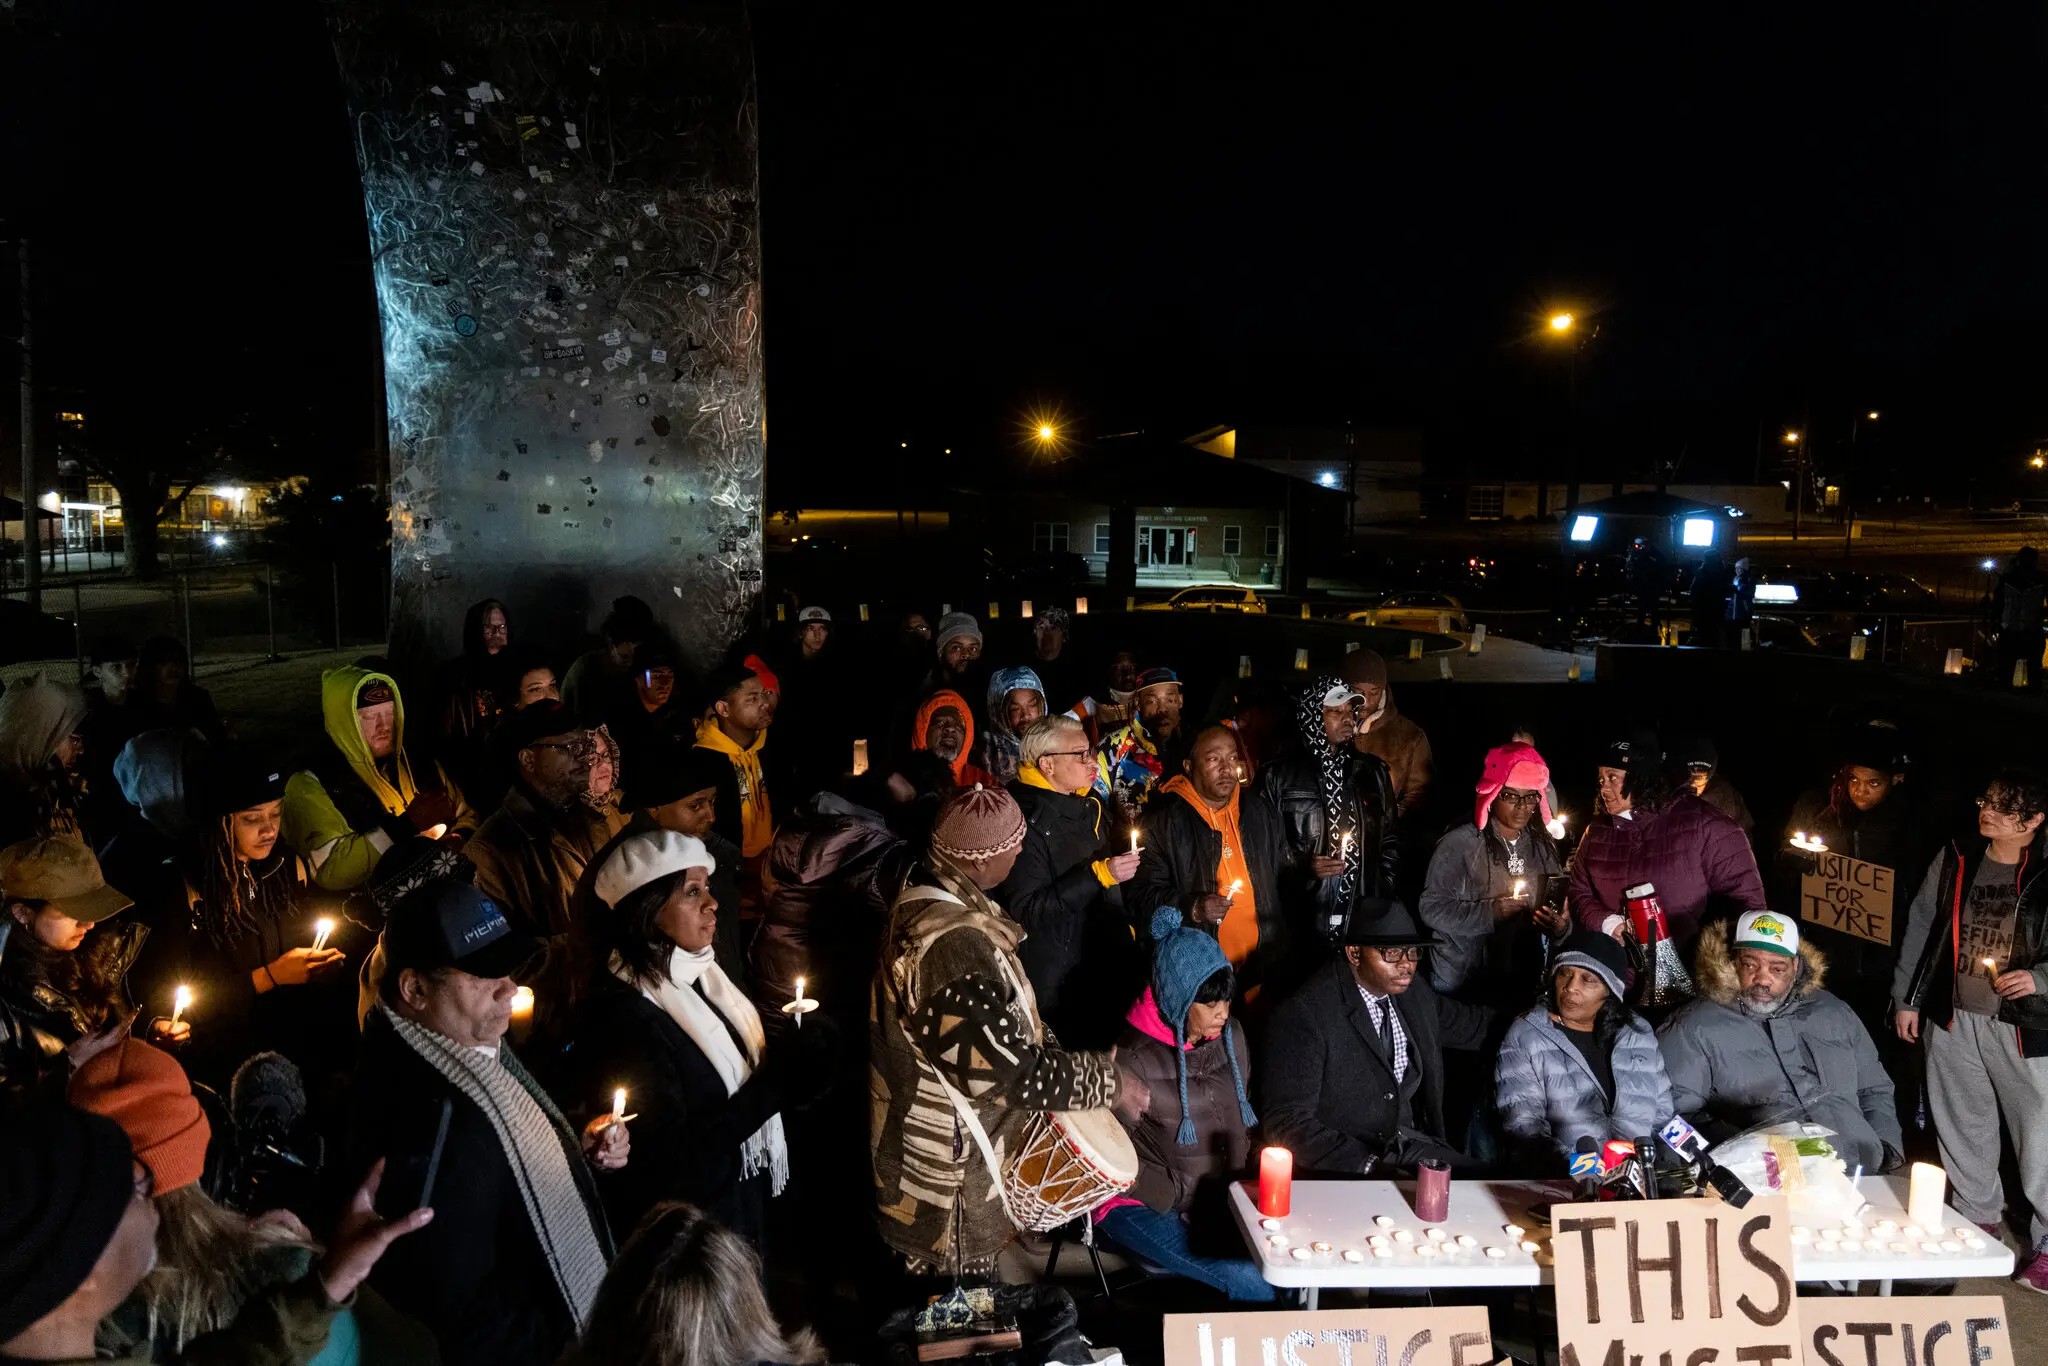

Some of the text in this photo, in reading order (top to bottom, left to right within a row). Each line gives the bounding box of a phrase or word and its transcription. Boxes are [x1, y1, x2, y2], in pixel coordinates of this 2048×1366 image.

[1807, 853, 1890, 893] JUSTICE
[1825, 882, 1868, 913] FOR
[1804, 893, 1889, 943] TYRE
[1663, 1119, 1689, 1144] 3
[1570, 1152, 1596, 1176] 5
[1559, 1215, 1791, 1327] THIS
[1813, 1317, 2000, 1366] STICE
